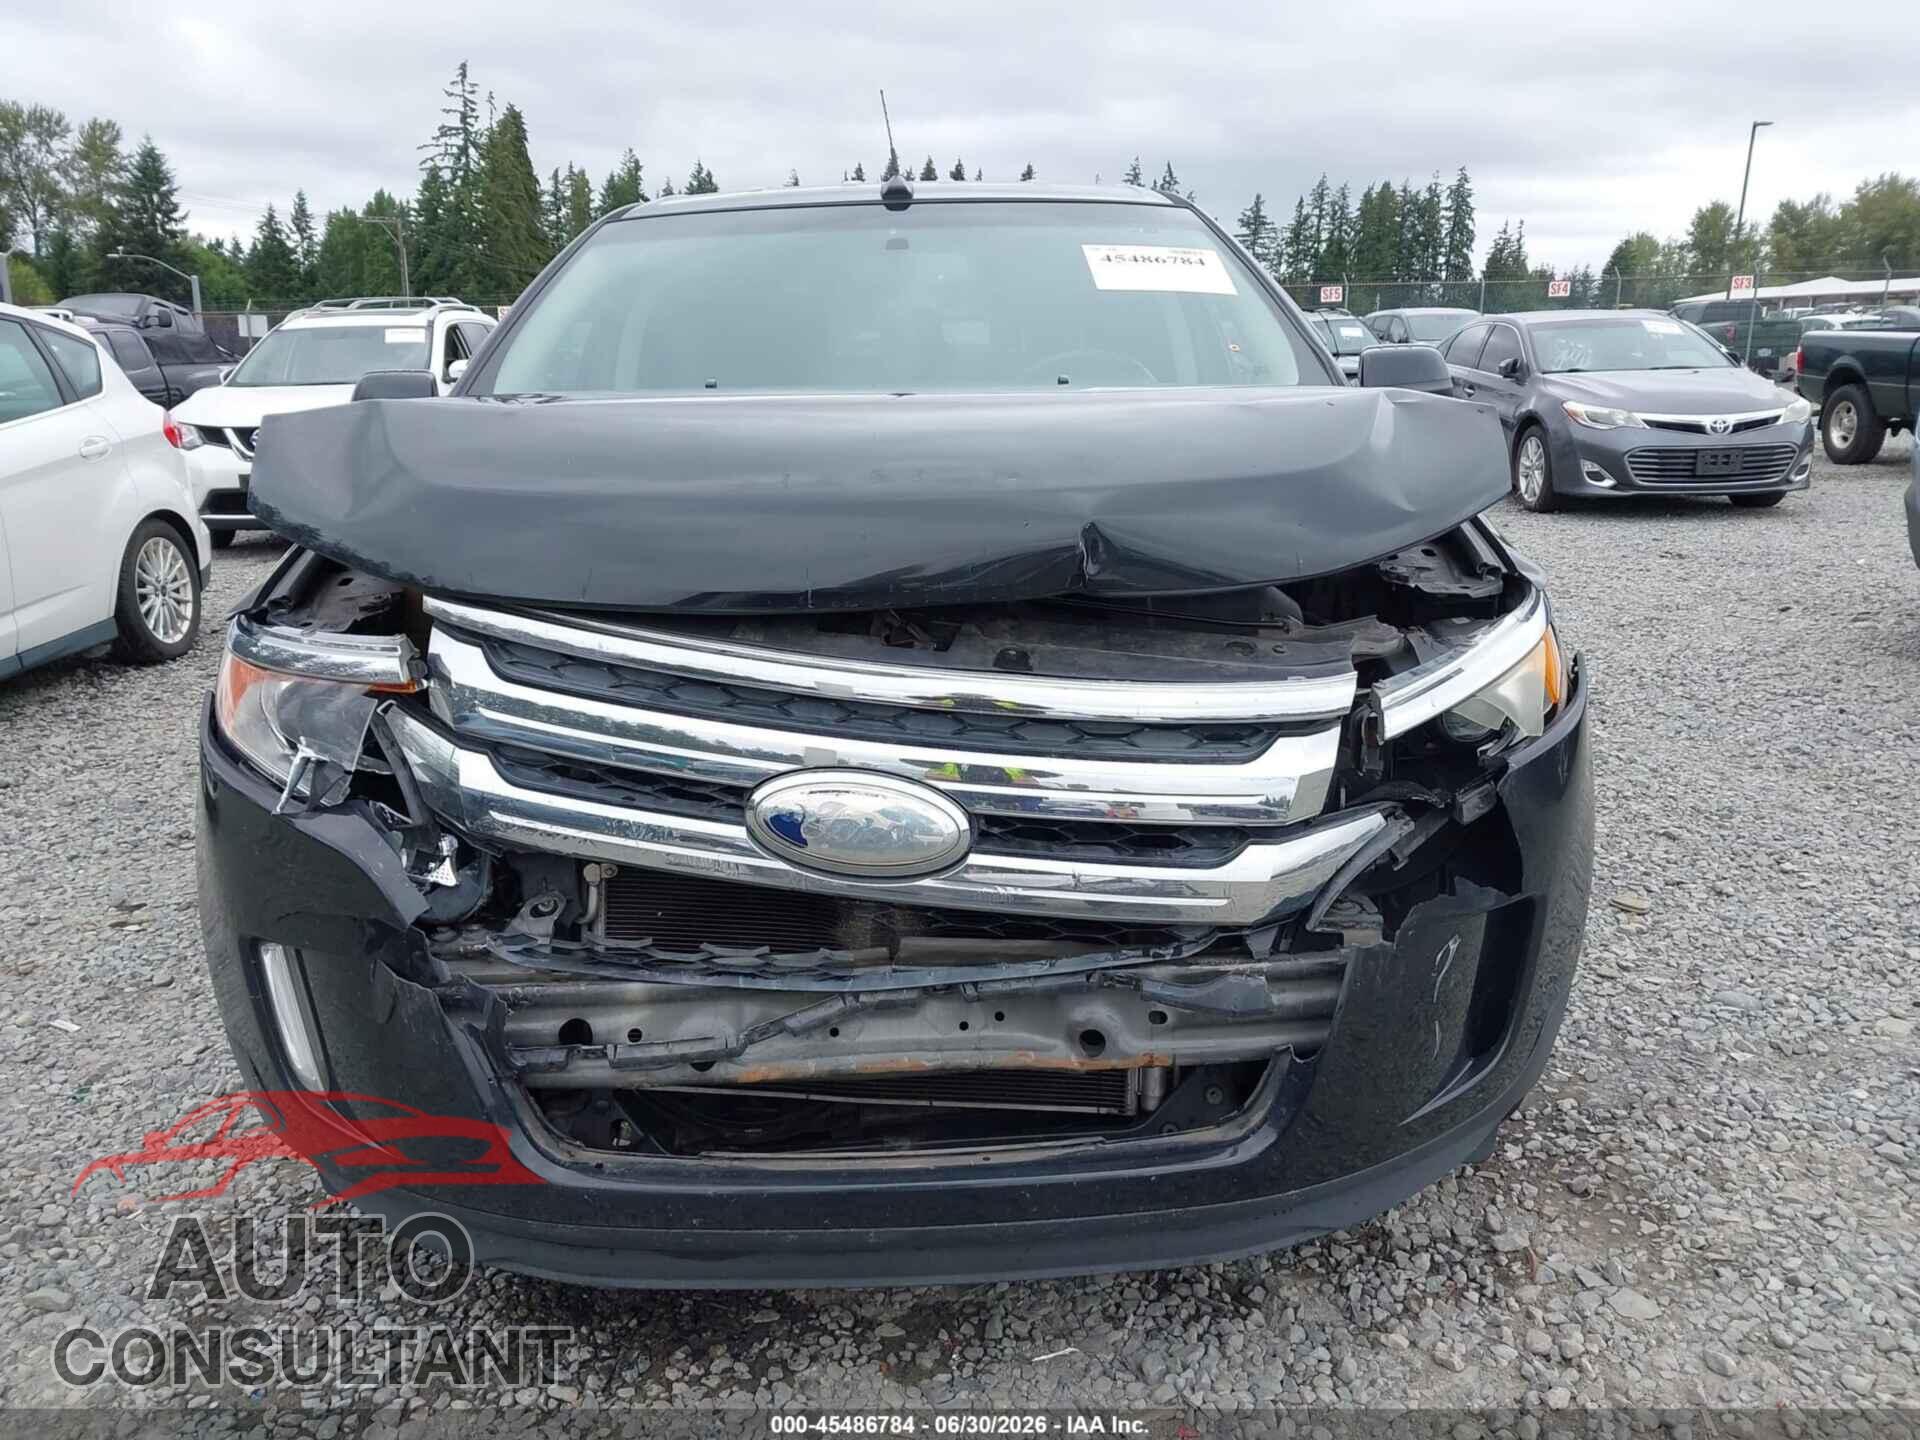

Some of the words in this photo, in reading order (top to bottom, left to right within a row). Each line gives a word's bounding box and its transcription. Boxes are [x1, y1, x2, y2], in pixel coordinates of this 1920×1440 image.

[1551, 283, 1569, 295] SF4
[1733, 277, 1752, 289] SF3
[1322, 287, 1341, 300] SF5
